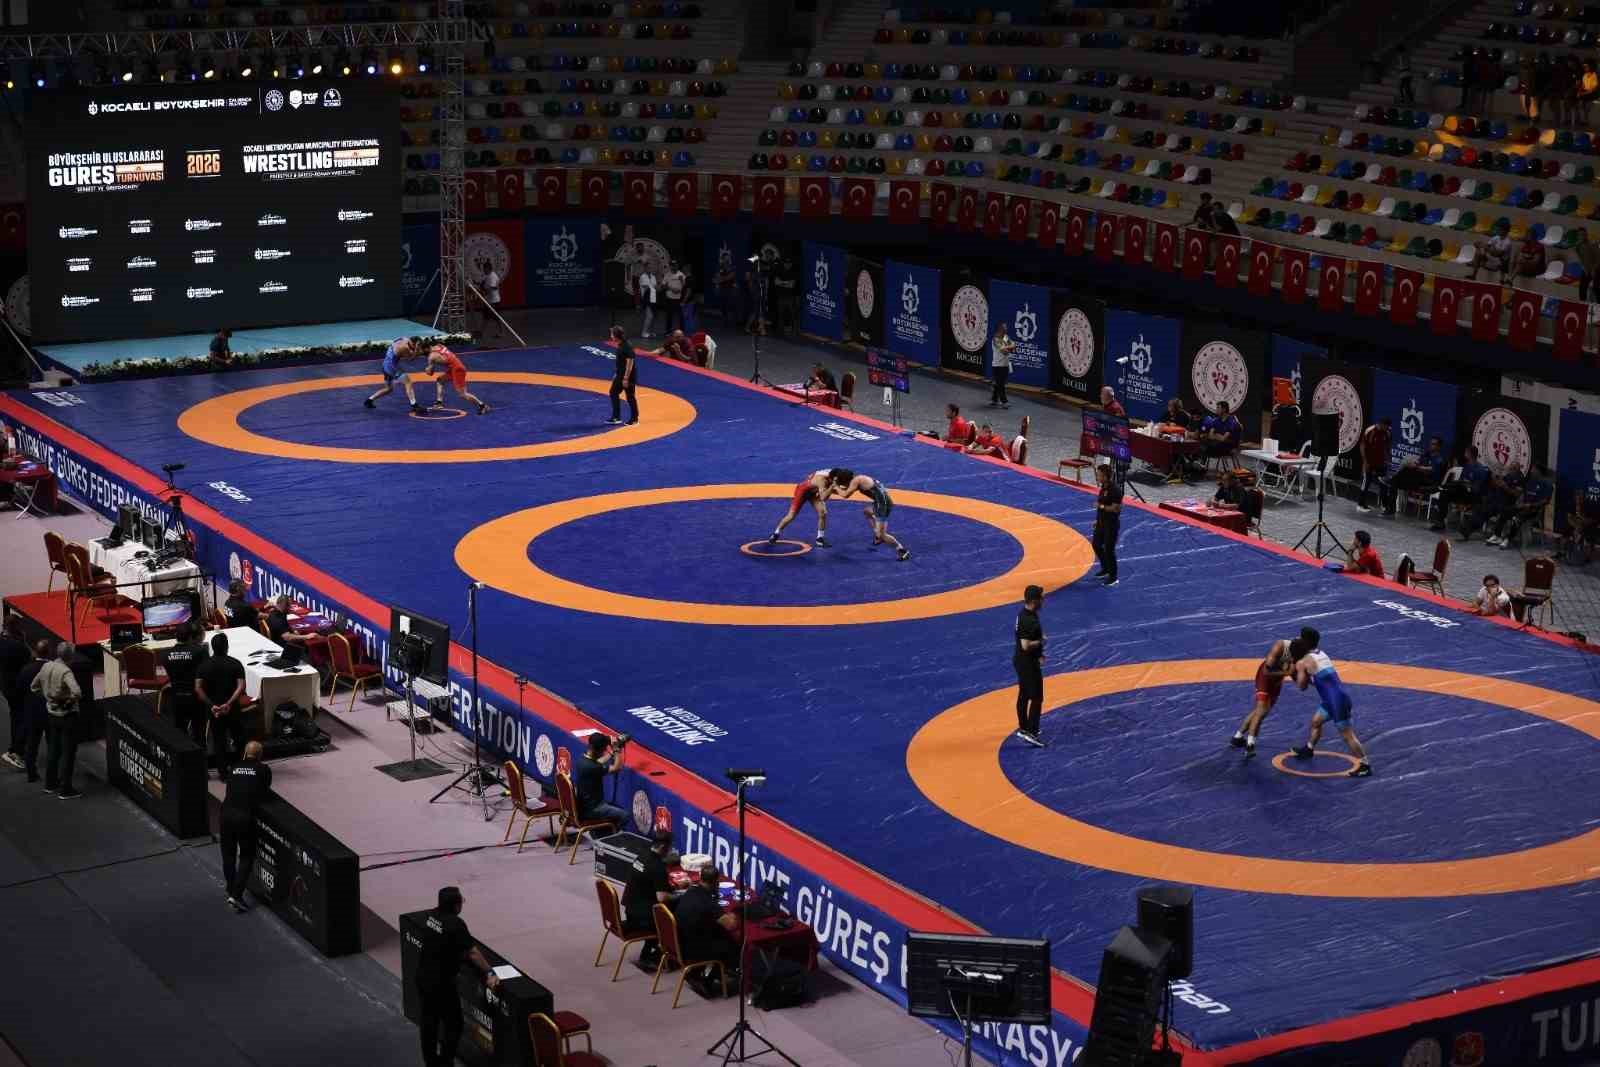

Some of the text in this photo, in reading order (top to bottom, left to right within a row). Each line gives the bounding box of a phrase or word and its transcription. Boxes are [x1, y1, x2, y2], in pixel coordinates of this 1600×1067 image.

[265, 142, 305, 151] METROPOLITAN
[305, 140, 341, 149] MUNICIPALITY
[341, 138, 380, 147] INTERNATIONAL
[102, 149, 164, 164] ULUSLARARASI
[186, 153, 221, 175] 2026
[243, 150, 333, 173] WRESTLING
[333, 157, 380, 168] TOURNAMENT
[448, 680, 532, 765] ERATION
[625, 705, 716, 746] WRESTLING
[690, 720, 729, 737] WORLD
[796, 884, 892, 985] GÜREŞ
[1168, 978, 1232, 1015] han
